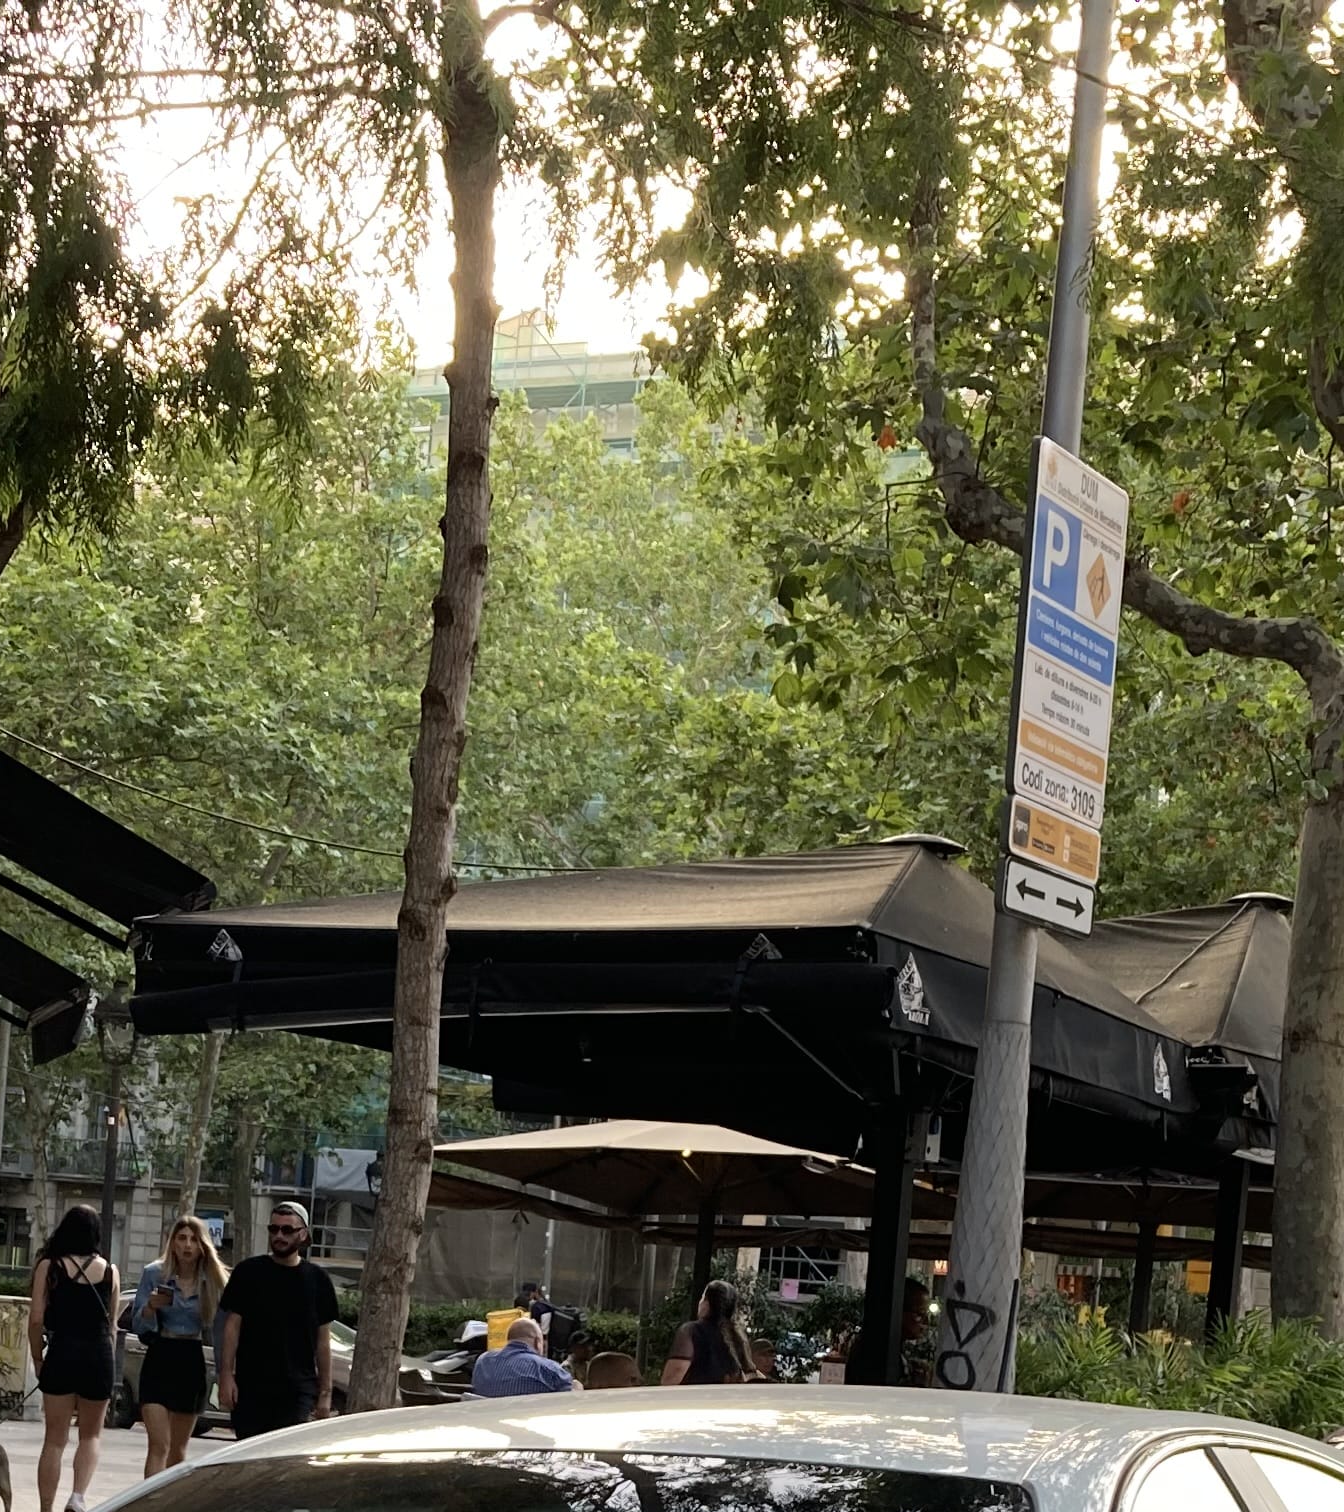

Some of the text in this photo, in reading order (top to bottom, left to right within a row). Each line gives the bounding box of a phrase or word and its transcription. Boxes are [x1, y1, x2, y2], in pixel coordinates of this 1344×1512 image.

[1080, 473, 1099, 503] DUM
[1042, 509, 1071, 589] P
[1021, 762, 1095, 819] Codi zona: 3109
